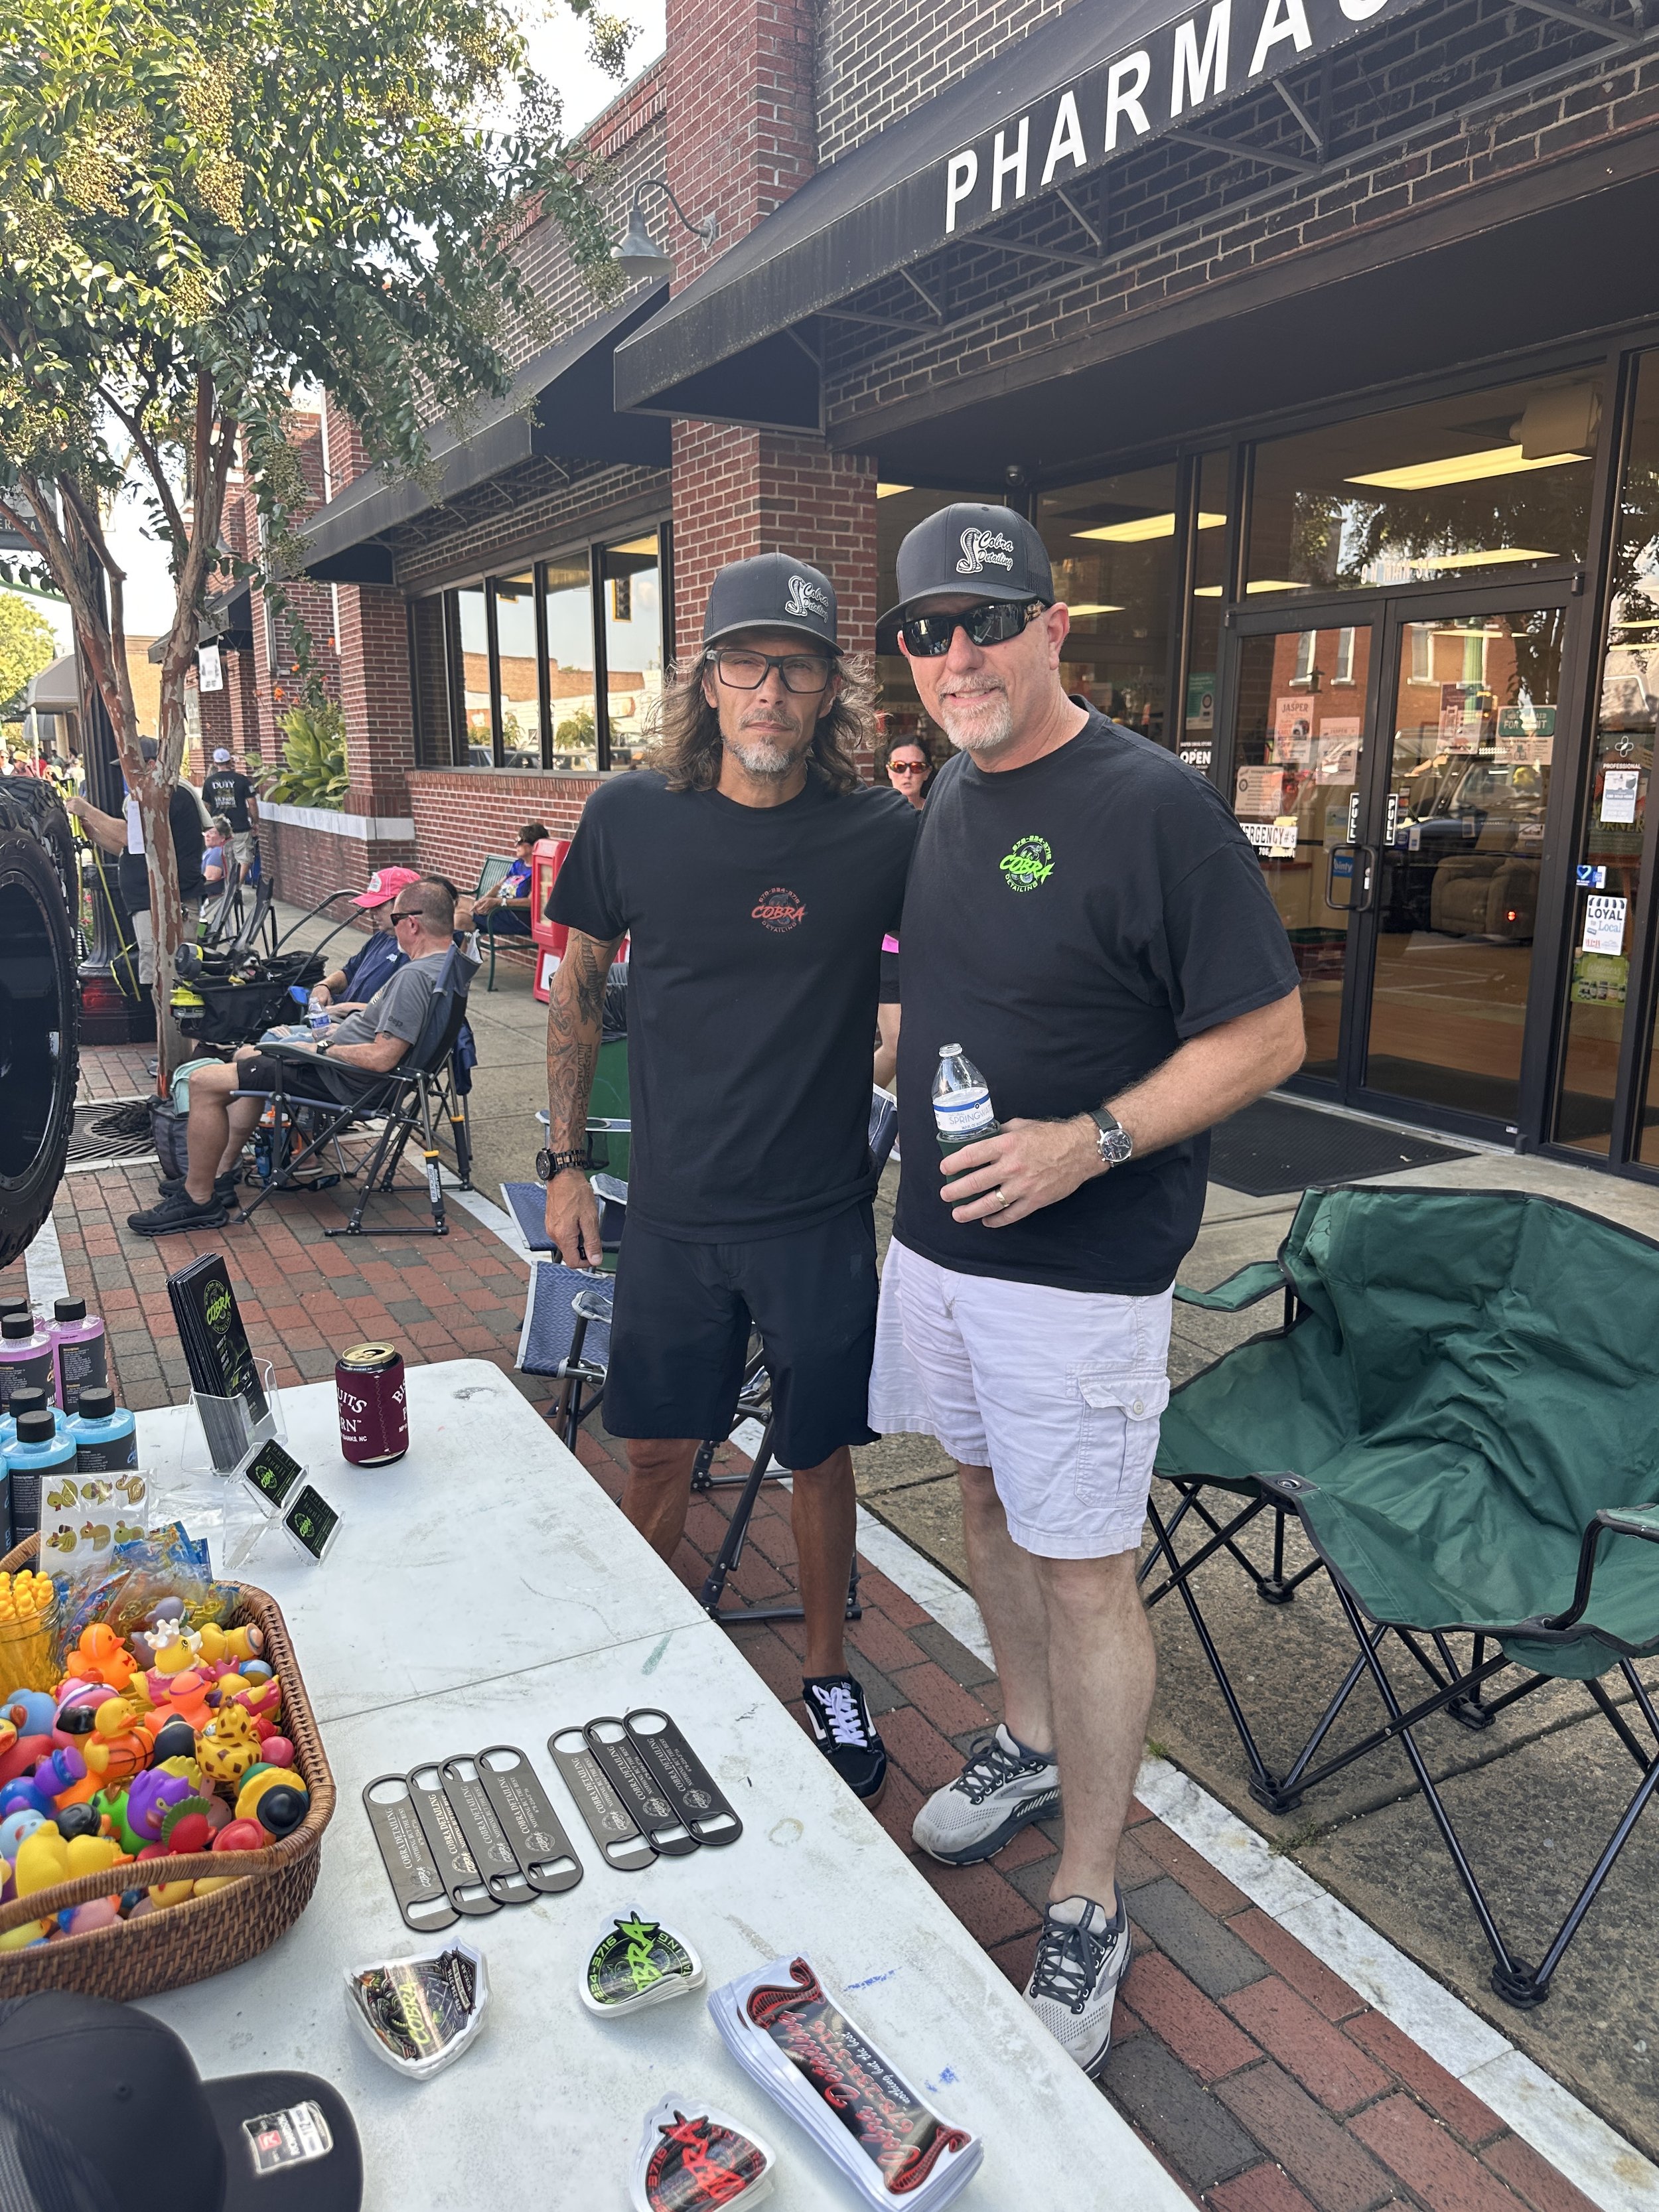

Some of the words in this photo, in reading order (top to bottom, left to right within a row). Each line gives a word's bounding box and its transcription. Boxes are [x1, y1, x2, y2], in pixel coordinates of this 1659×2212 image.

[978, 530, 1013, 552] Cobra
[977, 549, 1013, 571] Detailing
[803, 583, 829, 607] Cobra
[803, 597, 828, 623] Detailing
[1282, 703, 1309, 713] JASPER
[1180, 751, 1212, 765] OPEN
[212, 780, 235, 789] DUTY
[1350, 798, 1360, 838] PULL
[1386, 799, 1395, 840] PULL
[1241, 826, 1284, 845] ERGENCY
[999, 853, 1055, 885] COBRA
[1005, 873, 1038, 892] DETAILING
[751, 904, 808, 923] COBRA
[1587, 907, 1623, 921] LOYAL
[762, 921, 797, 932] DETAILING
[1598, 921, 1621, 932] Local
[388, 1015, 403, 1027] eep
[206, 1287, 231, 1325] COBRA
[607, 1745, 632, 1779] DETAILING
[647, 1738, 672, 1770] DETAILING
[571, 1757, 595, 1791] DETAILING
[668, 1769, 686, 1792] COBRA
[497, 1776, 520, 1811] DETAILING
[628, 1778, 646, 1801] COBRA
[428, 1794, 449, 1830] DETAILING
[461, 1785, 482, 1820] DETAILING
[589, 1791, 606, 1814] COBRA
[386, 1807, 404, 1845] DETAILING
[476, 1820, 492, 1844] COBRA
[514, 1810, 530, 1834] COBRA
[442, 1830, 458, 1854] COBRA
[398, 1844, 413, 1869] COBRA
[447, 1968, 462, 2010] 678-234-3716
[461, 1963, 472, 1992] BOXCAR
[399, 1982, 431, 2044] COBRA
[776, 2010, 861, 2108] Detailing
[857, 2047, 873, 2061] the
[809, 2020, 914, 2134] 678-234-3716
[867, 2060, 884, 2075] but
[855, 2105, 922, 2165] Cobra
